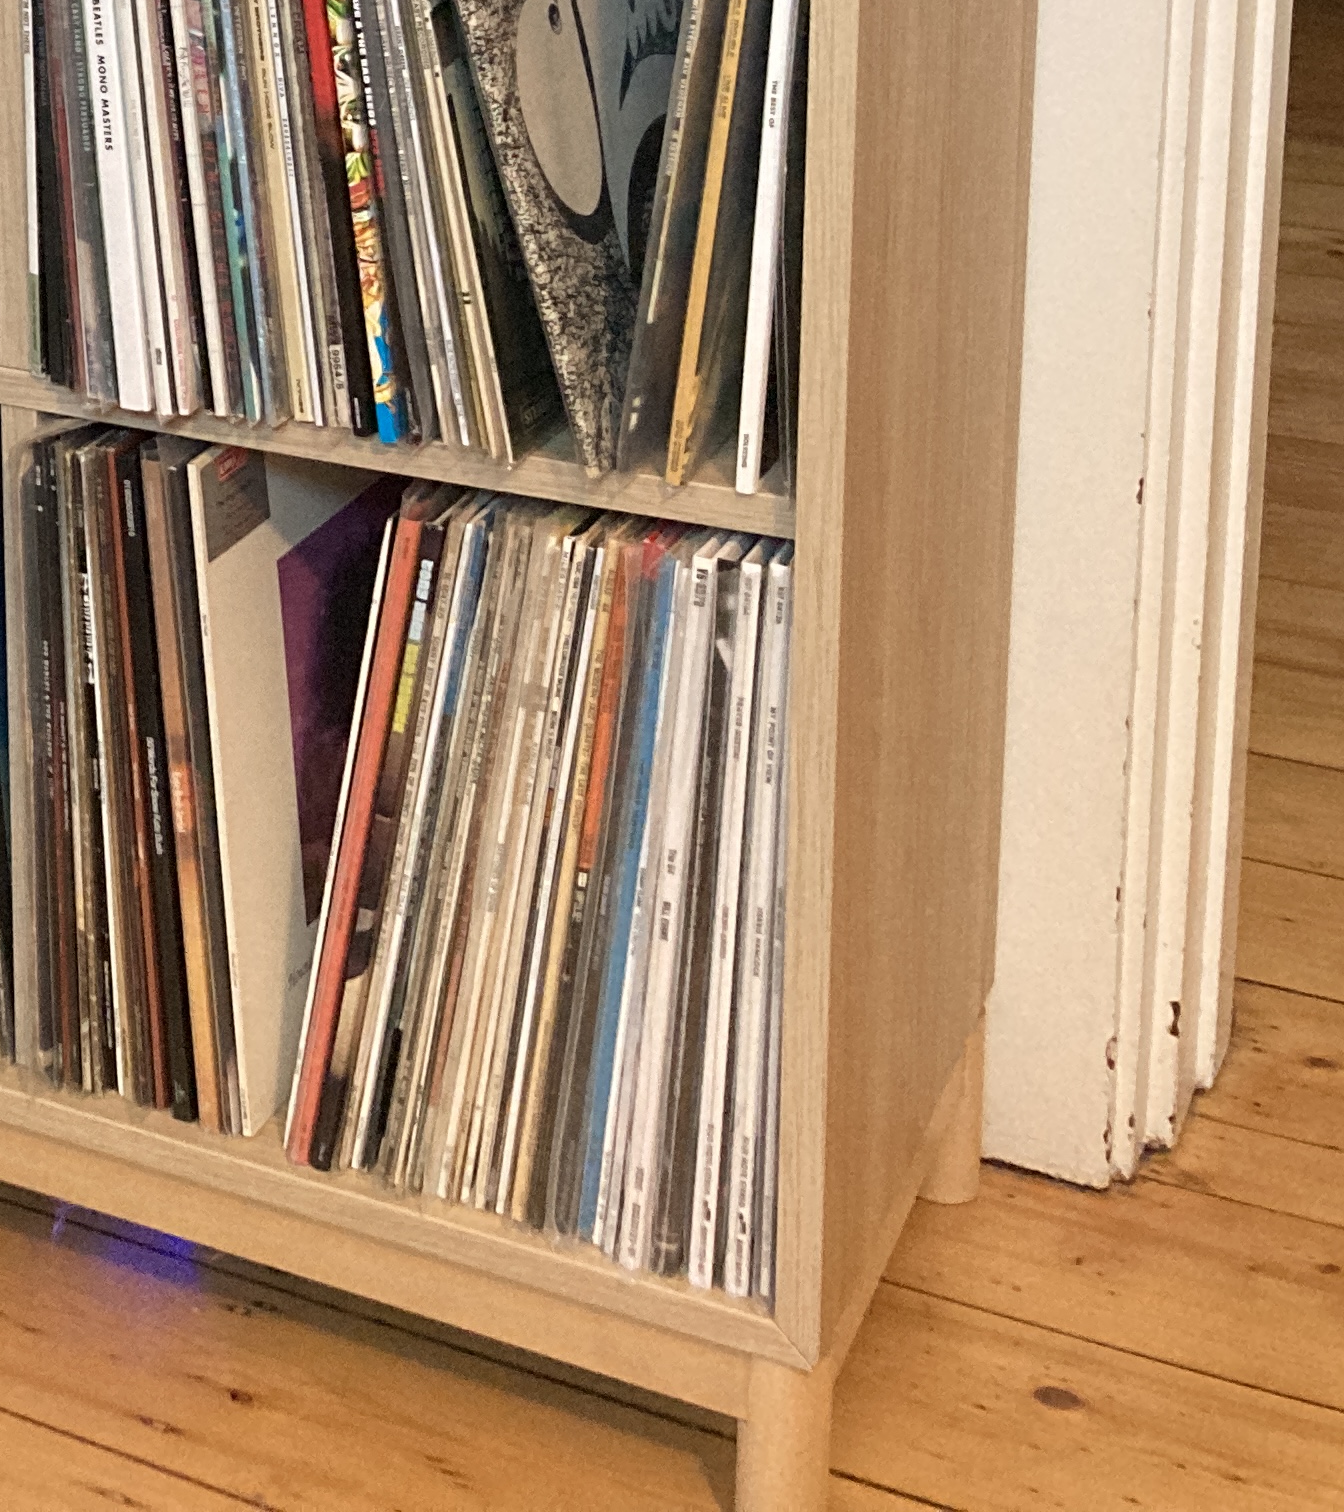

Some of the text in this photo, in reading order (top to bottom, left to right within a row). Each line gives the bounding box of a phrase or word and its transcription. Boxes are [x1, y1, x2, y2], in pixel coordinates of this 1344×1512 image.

[91, 0, 104, 46] BEATLES
[96, 54, 108, 94] MONO
[101, 99, 113, 151] MASTERS
